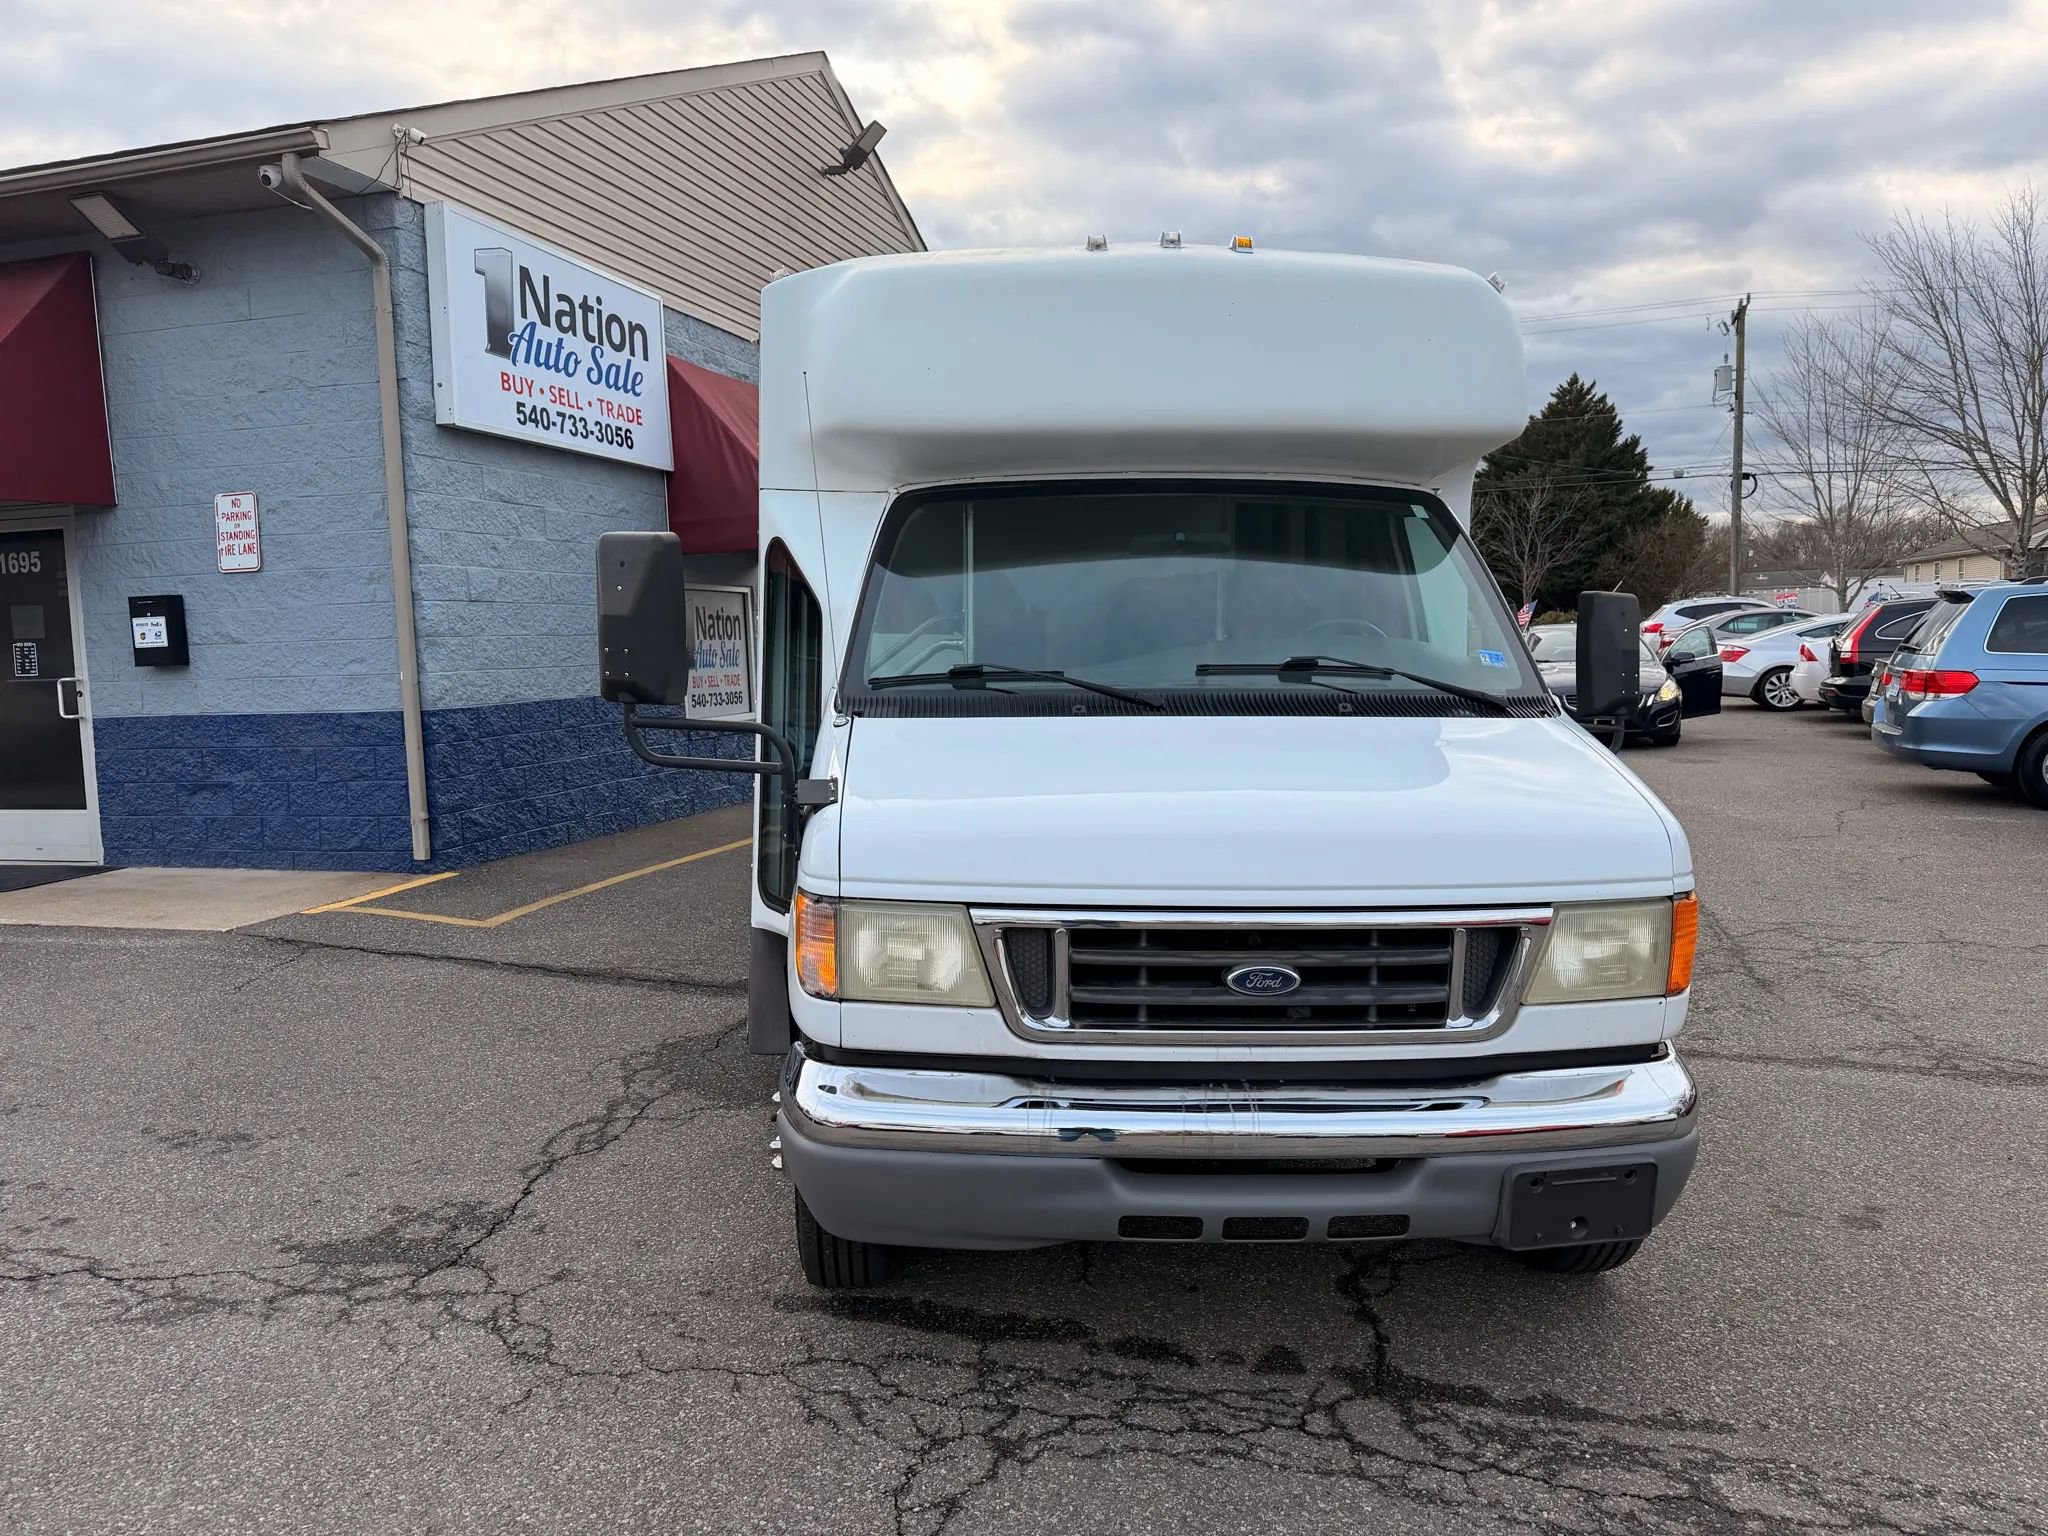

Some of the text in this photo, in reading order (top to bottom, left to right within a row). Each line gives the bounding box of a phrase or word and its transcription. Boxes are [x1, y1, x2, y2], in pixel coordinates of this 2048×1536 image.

[519, 265, 649, 362] Nation
[509, 321, 644, 397] Auto Sale
[500, 371, 643, 426] BUY SELL TRADE
[516, 401, 634, 450] 540-733-3056
[231, 498, 241, 509] NO
[221, 511, 252, 521] PARKING
[221, 530, 256, 541] STANDING
[238, 543, 256, 555] LANE
[0, 551, 41, 574] 1695
[695, 605, 741, 640] Nation
[693, 640, 740, 672] Auto Sale
[692, 673, 741, 688] BUY SELL TRADE
[691, 690, 744, 709] 540-733-3056
[1246, 971, 1283, 988] Ford
